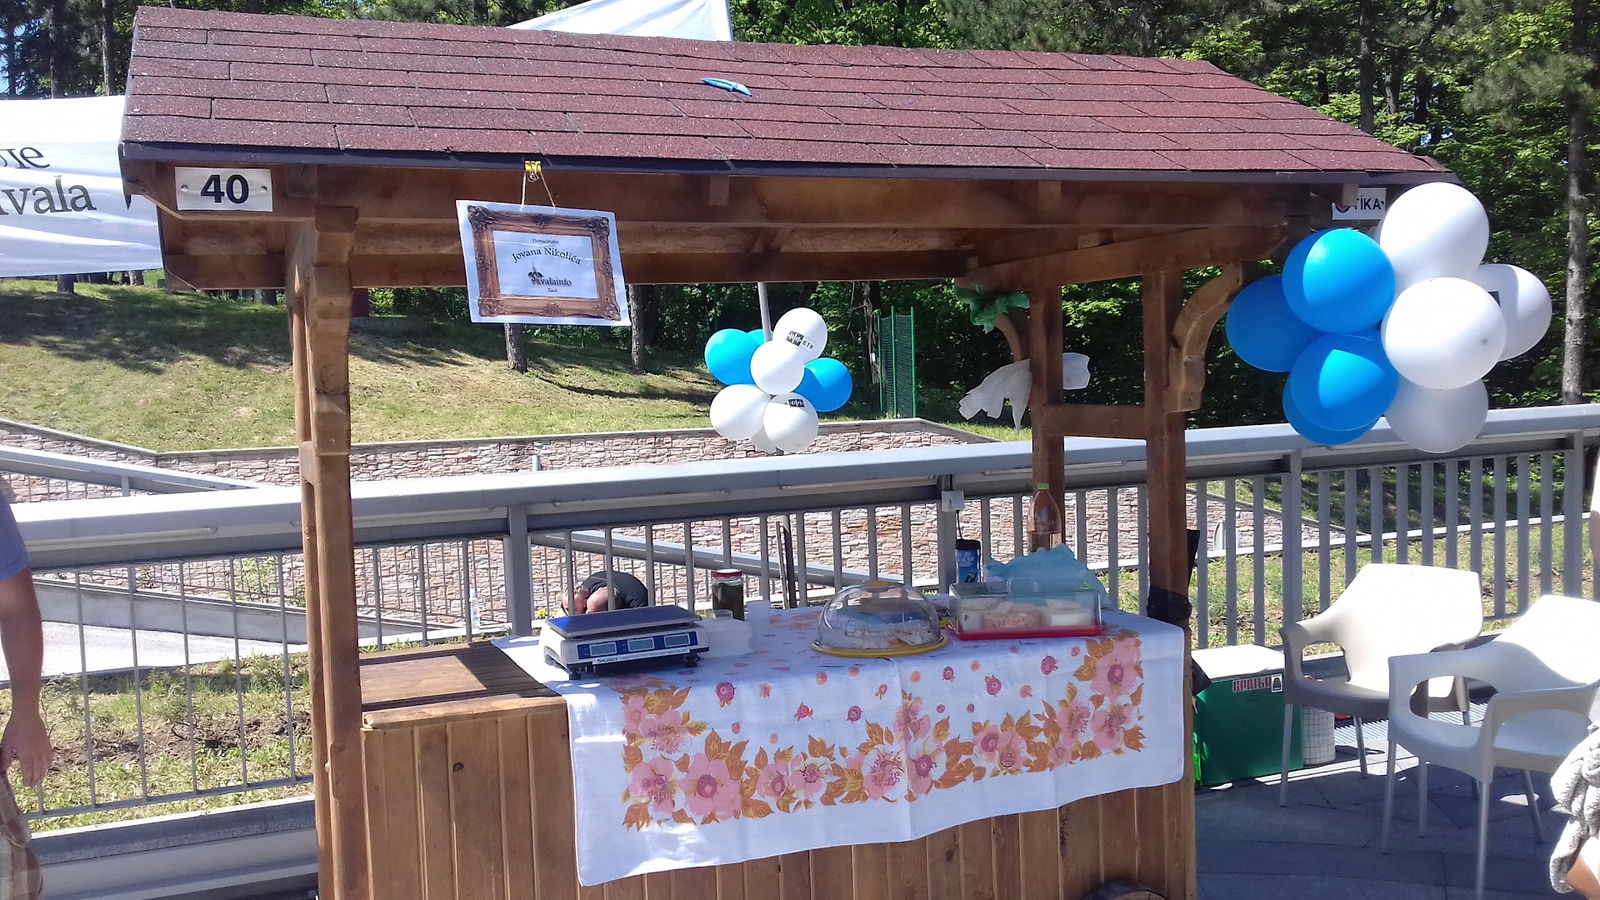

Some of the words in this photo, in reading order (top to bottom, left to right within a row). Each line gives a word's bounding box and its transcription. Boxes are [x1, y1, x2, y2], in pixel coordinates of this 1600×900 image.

[0, 175, 97, 215] vala
[200, 174, 249, 204] 40
[511, 248, 542, 264] Jovana
[544, 247, 581, 265] Nikolića
